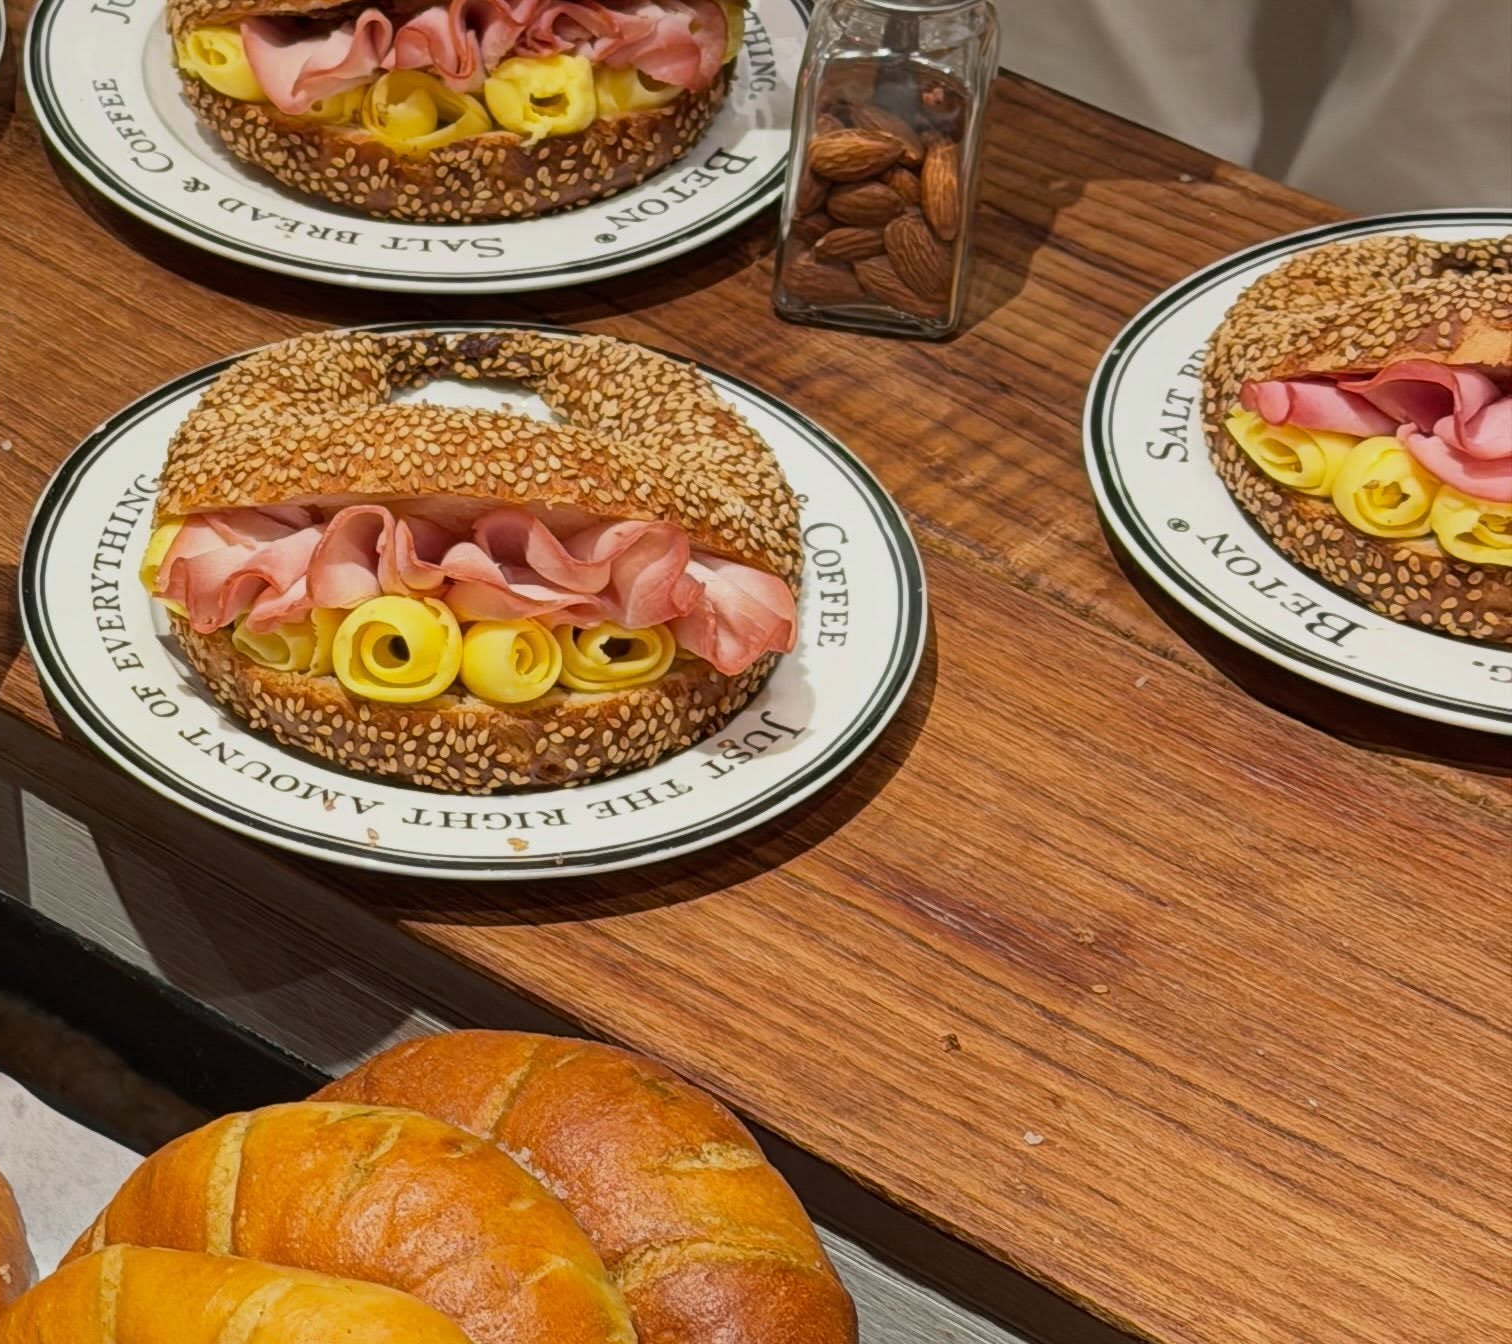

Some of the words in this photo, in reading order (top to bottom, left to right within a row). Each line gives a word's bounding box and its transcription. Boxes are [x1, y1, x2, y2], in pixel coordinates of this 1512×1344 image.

[92, 78, 174, 173] COFFEE
[182, 176, 211, 193] &
[218, 197, 363, 245] BREAD
[381, 235, 505, 259] SALT
[1146, 388, 1194, 462] SALT
[803, 522, 849, 648] COFFEE
[131, 684, 180, 718] OF
[700, 710, 807, 780] JUST
[178, 727, 385, 815] AMOUNT
[401, 807, 573, 831] RIGHT
[586, 778, 695, 820] THE
